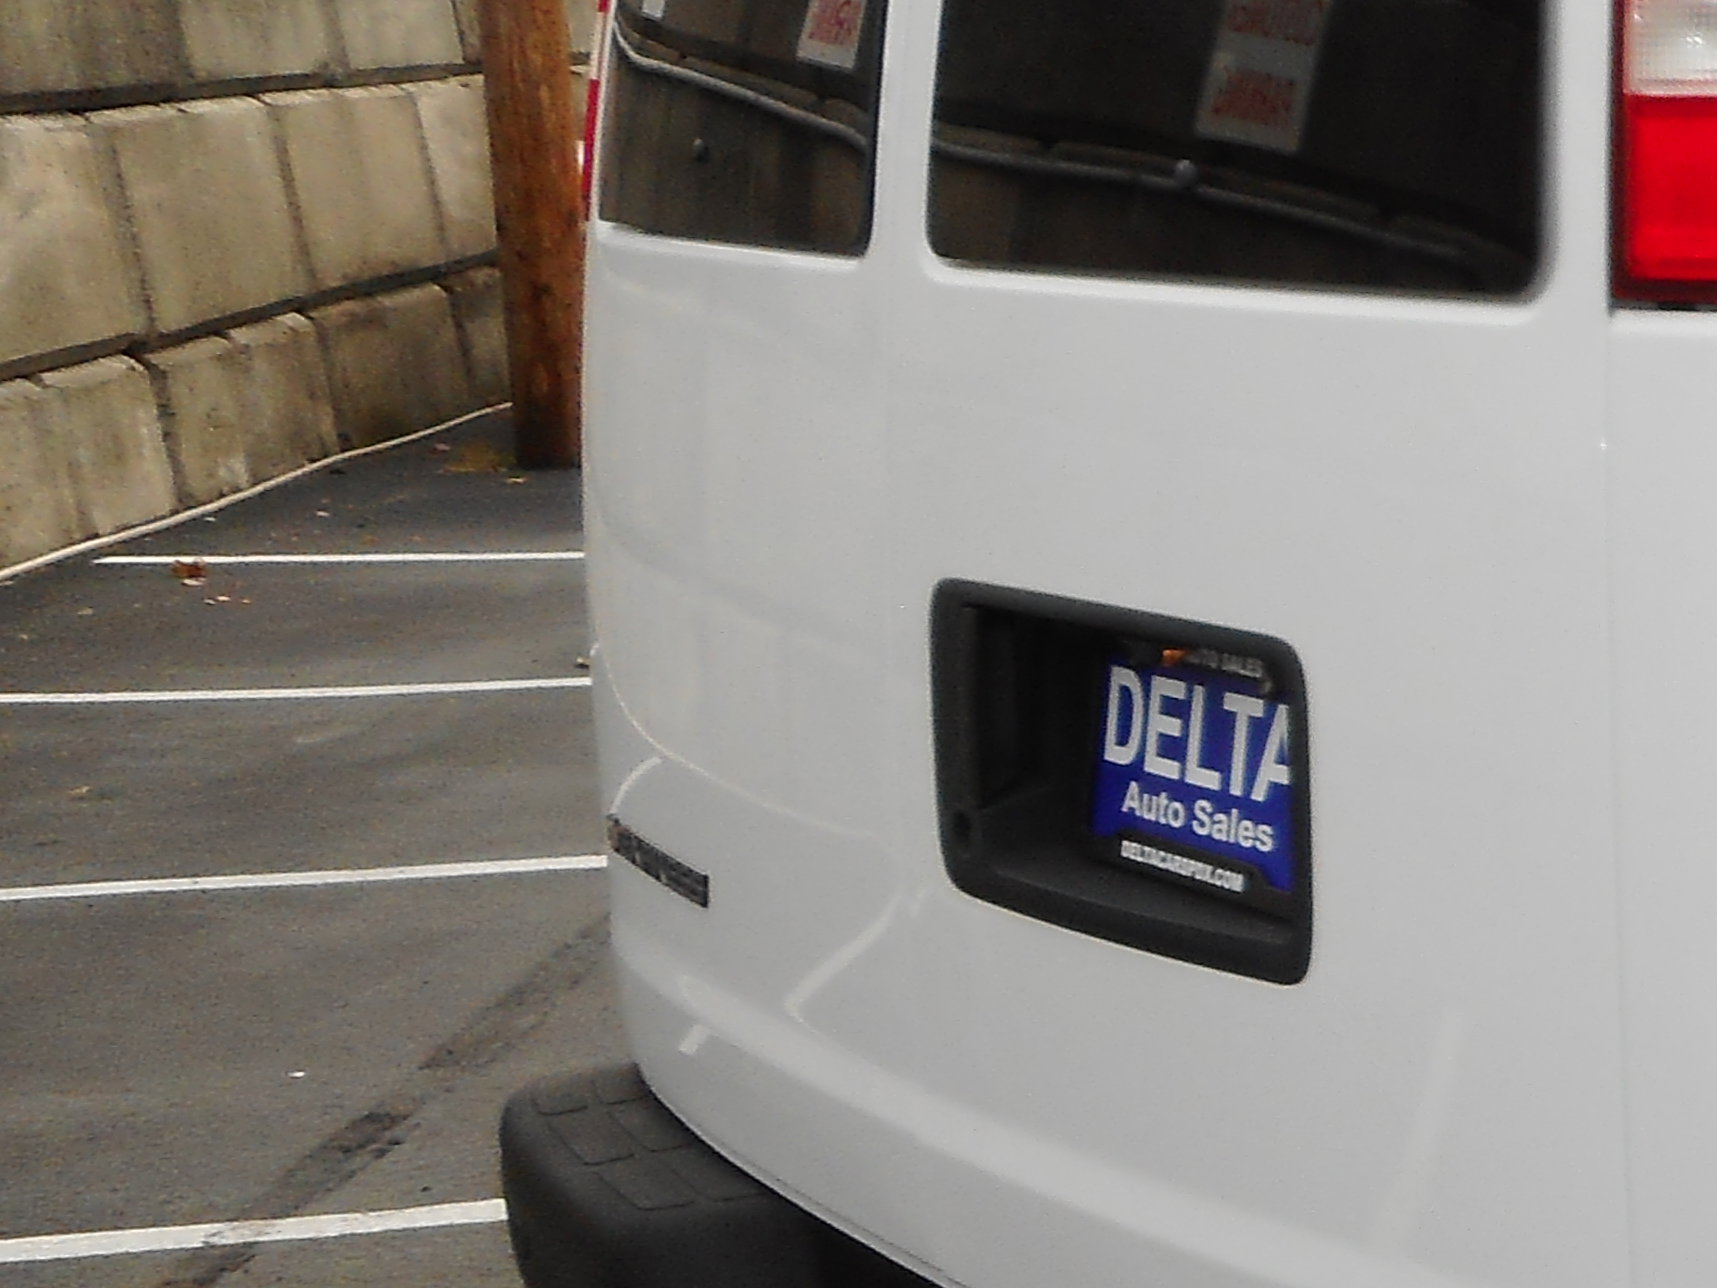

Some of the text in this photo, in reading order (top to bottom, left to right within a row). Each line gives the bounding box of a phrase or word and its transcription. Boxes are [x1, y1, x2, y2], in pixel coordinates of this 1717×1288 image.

[1104, 666, 1291, 801] DELTA
[1122, 782, 1274, 852] Auto Sales
